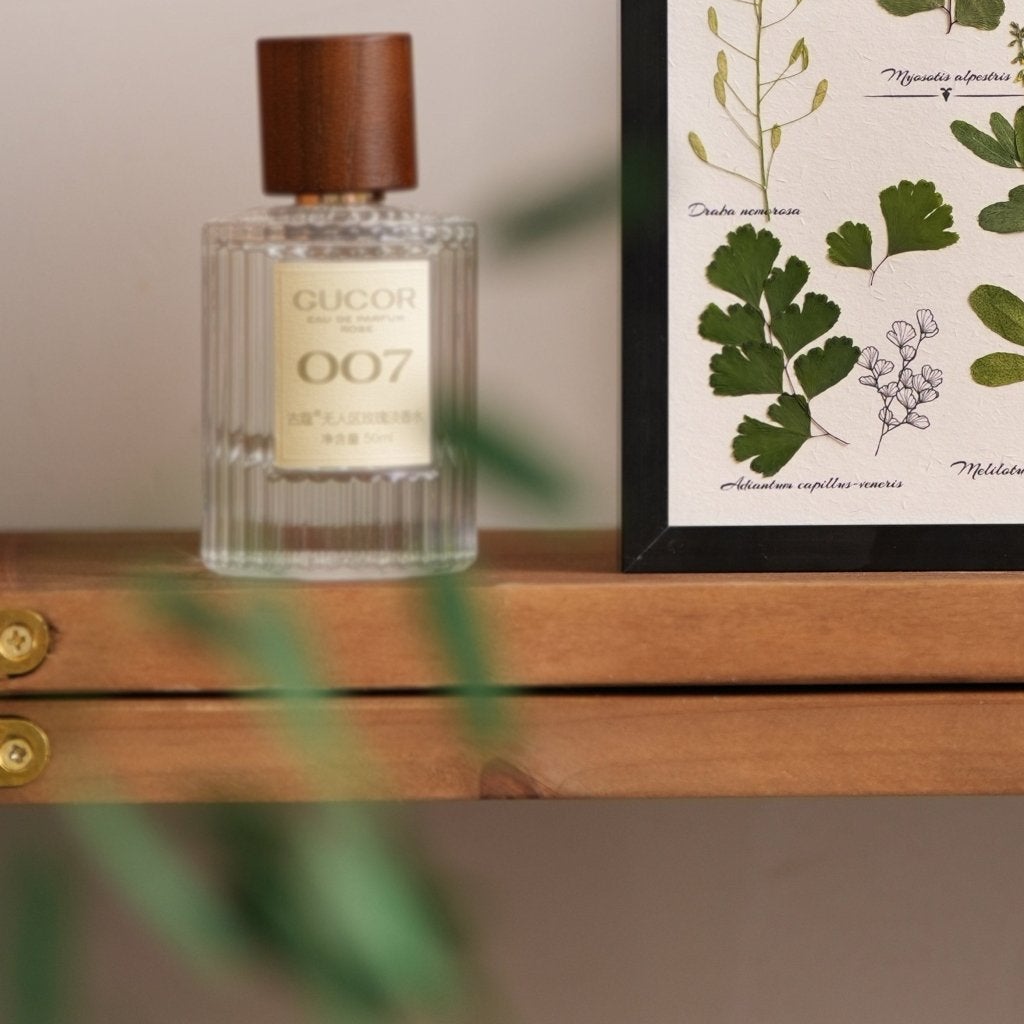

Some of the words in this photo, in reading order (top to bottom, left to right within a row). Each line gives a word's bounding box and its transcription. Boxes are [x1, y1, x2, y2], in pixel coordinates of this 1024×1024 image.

[880, 68, 951, 87] Myosotis
[954, 69, 1012, 85] alpestris
[688, 202, 735, 217] Draba
[293, 288, 416, 311] GUCOR
[720, 476, 793, 491] Adiantum
[797, 477, 904, 494] capillus-veneris
